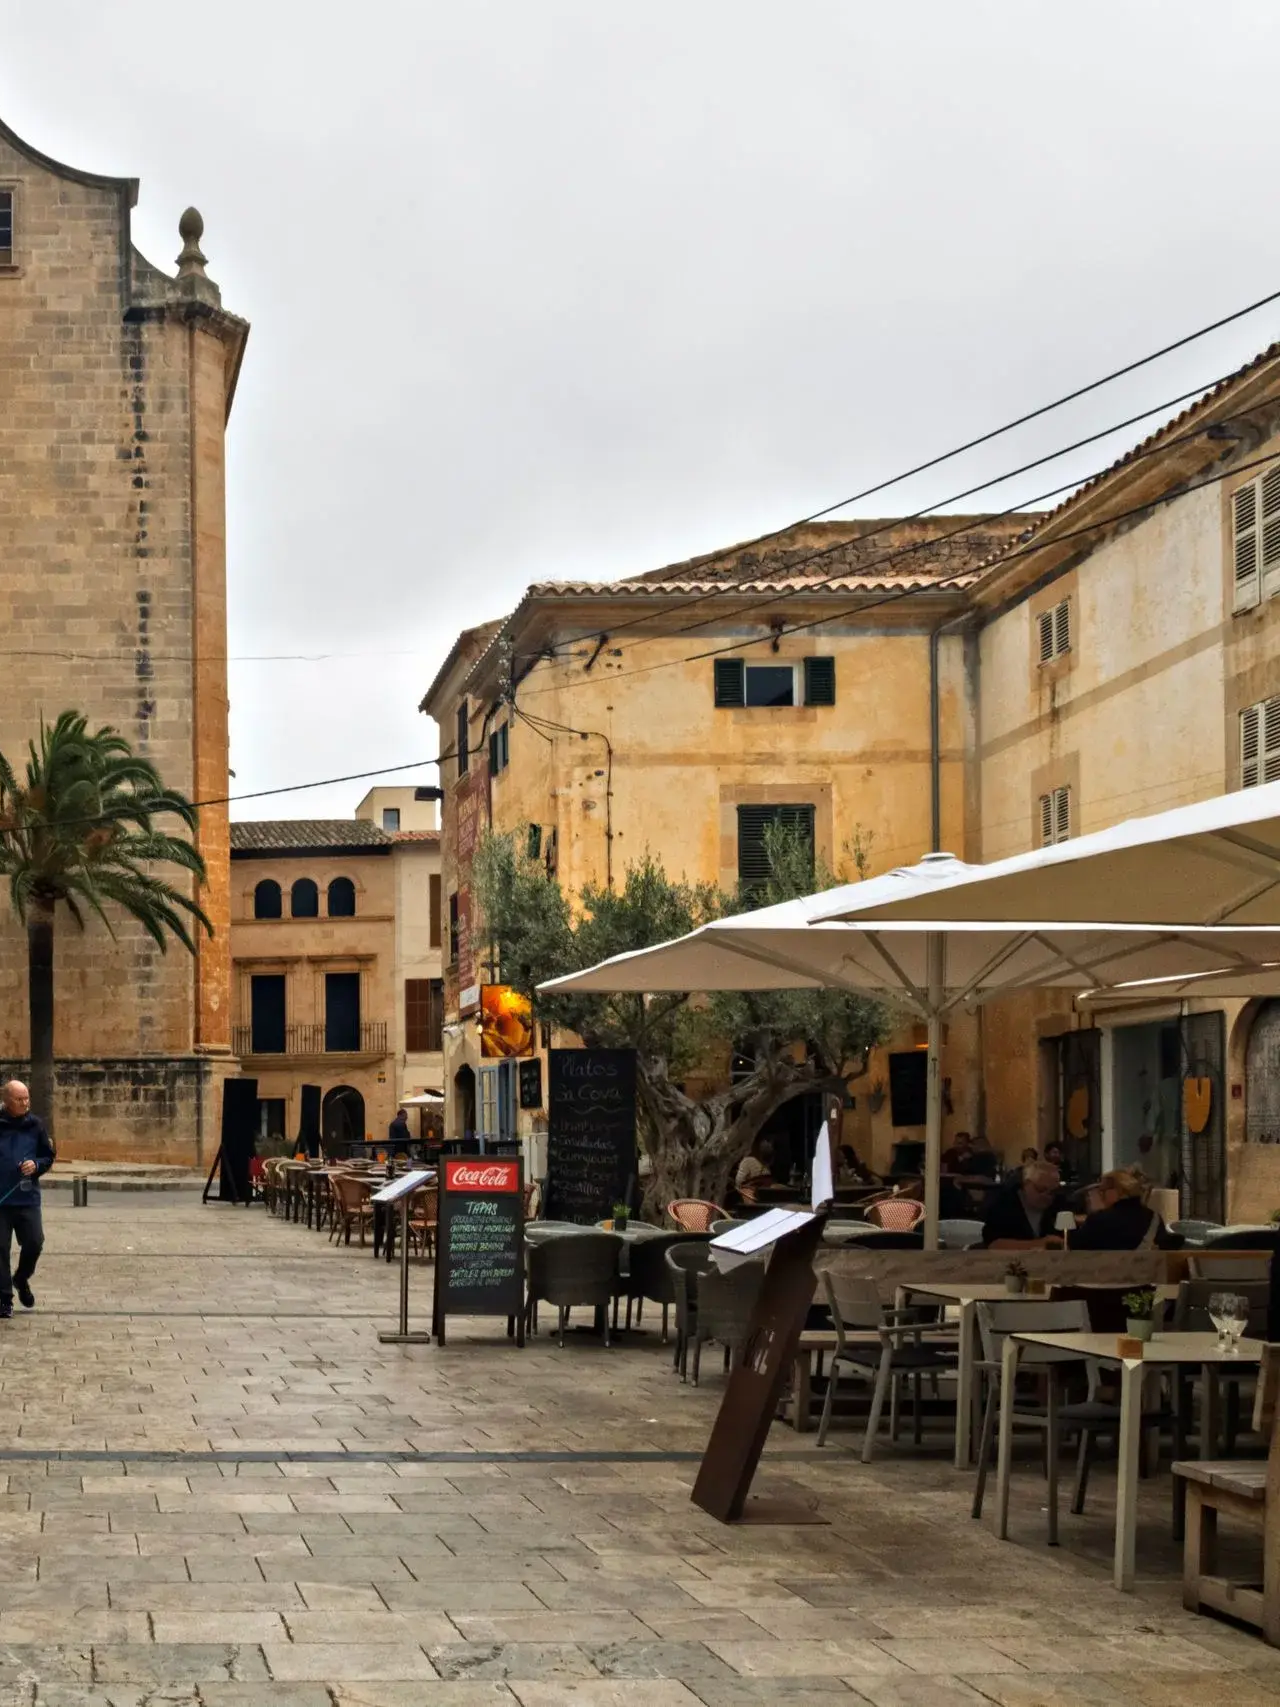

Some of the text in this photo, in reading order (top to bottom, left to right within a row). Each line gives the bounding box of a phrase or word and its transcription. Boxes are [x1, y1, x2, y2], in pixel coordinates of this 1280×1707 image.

[561, 1054, 619, 1077] Platos
[578, 1083, 622, 1101] Cova
[452, 1166, 511, 1186] Coca-Cola
[465, 1201, 498, 1215] TAPAS
